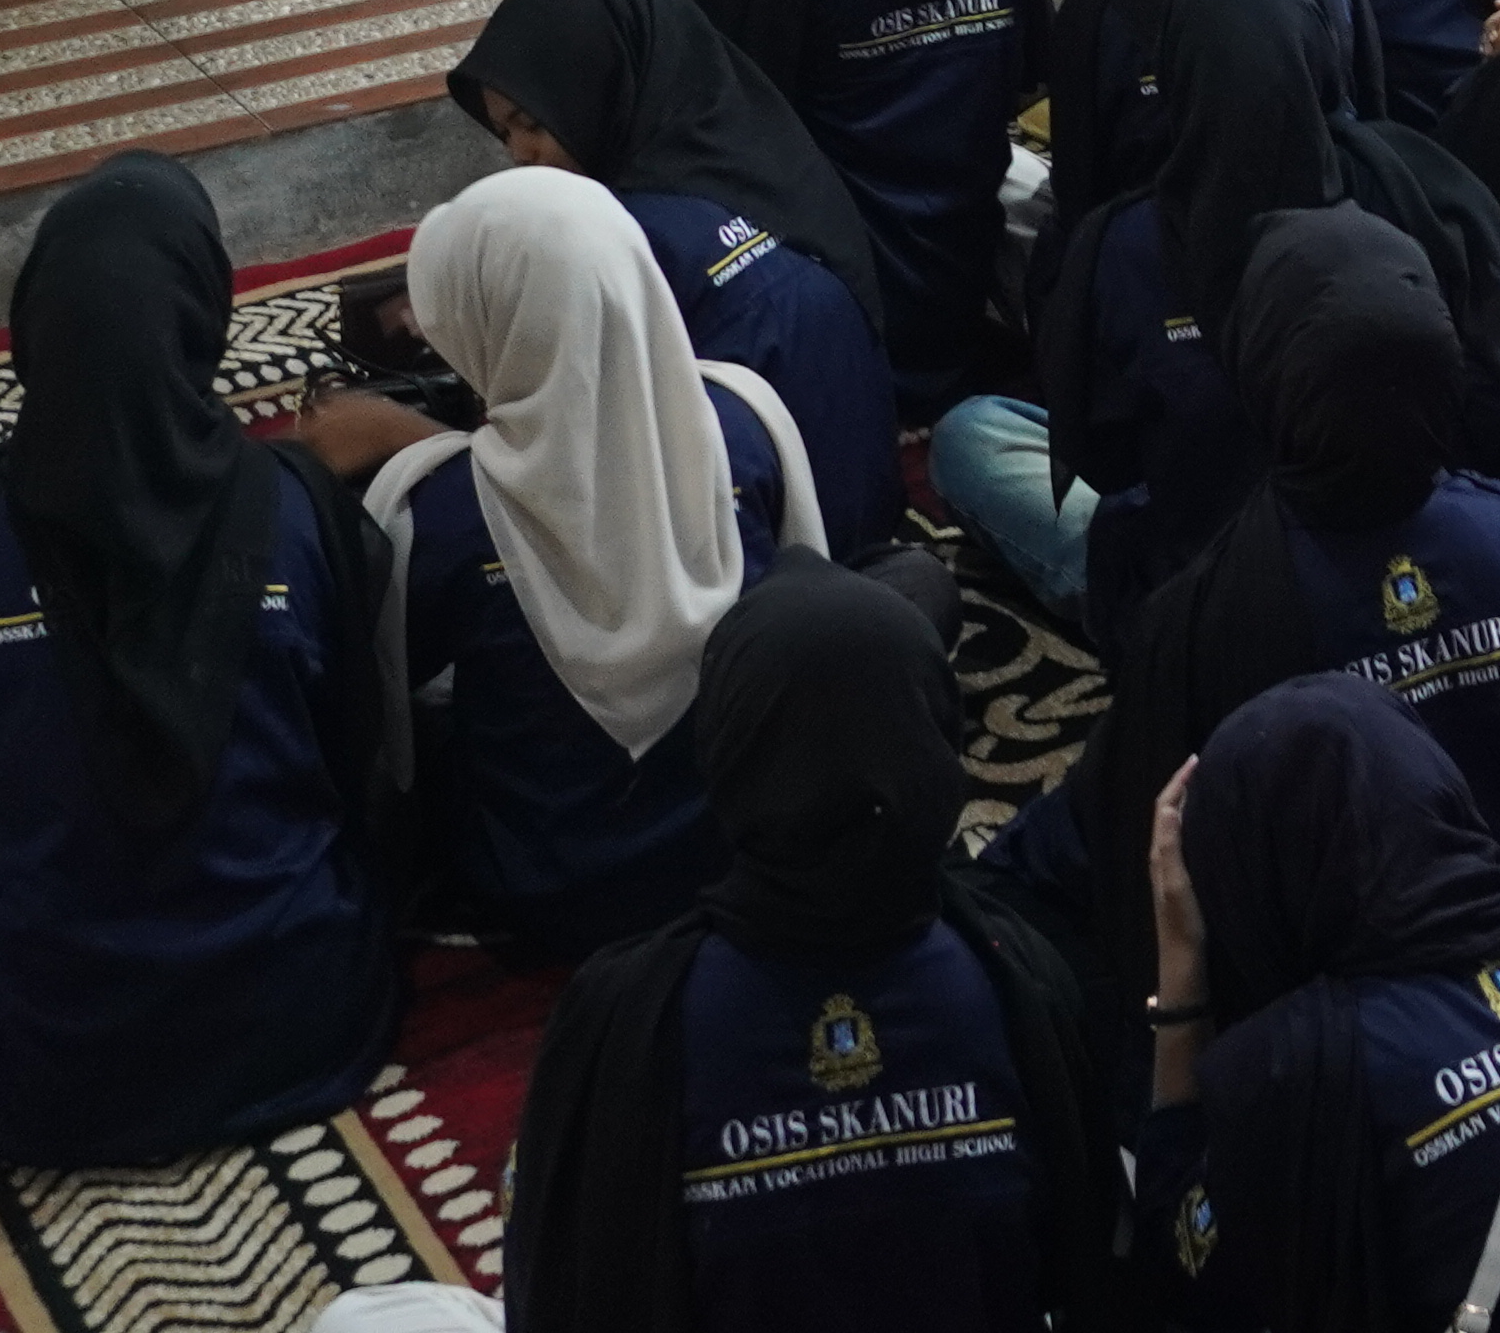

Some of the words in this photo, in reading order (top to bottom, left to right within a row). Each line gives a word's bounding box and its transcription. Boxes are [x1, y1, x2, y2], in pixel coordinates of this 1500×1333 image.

[870, 8, 914, 39] OSIS
[1167, 323, 1202, 343] OSSK
[1457, 665, 1500, 688] HIGH
[721, 1109, 809, 1161] OSIS
[818, 1081, 979, 1145] SKANURI
[1412, 1112, 1487, 1168] OSSKAN
[760, 1148, 889, 1194] VOCATIONAL
[894, 1140, 948, 1169] HIGH
[951, 1132, 1018, 1161] SCHOOL
